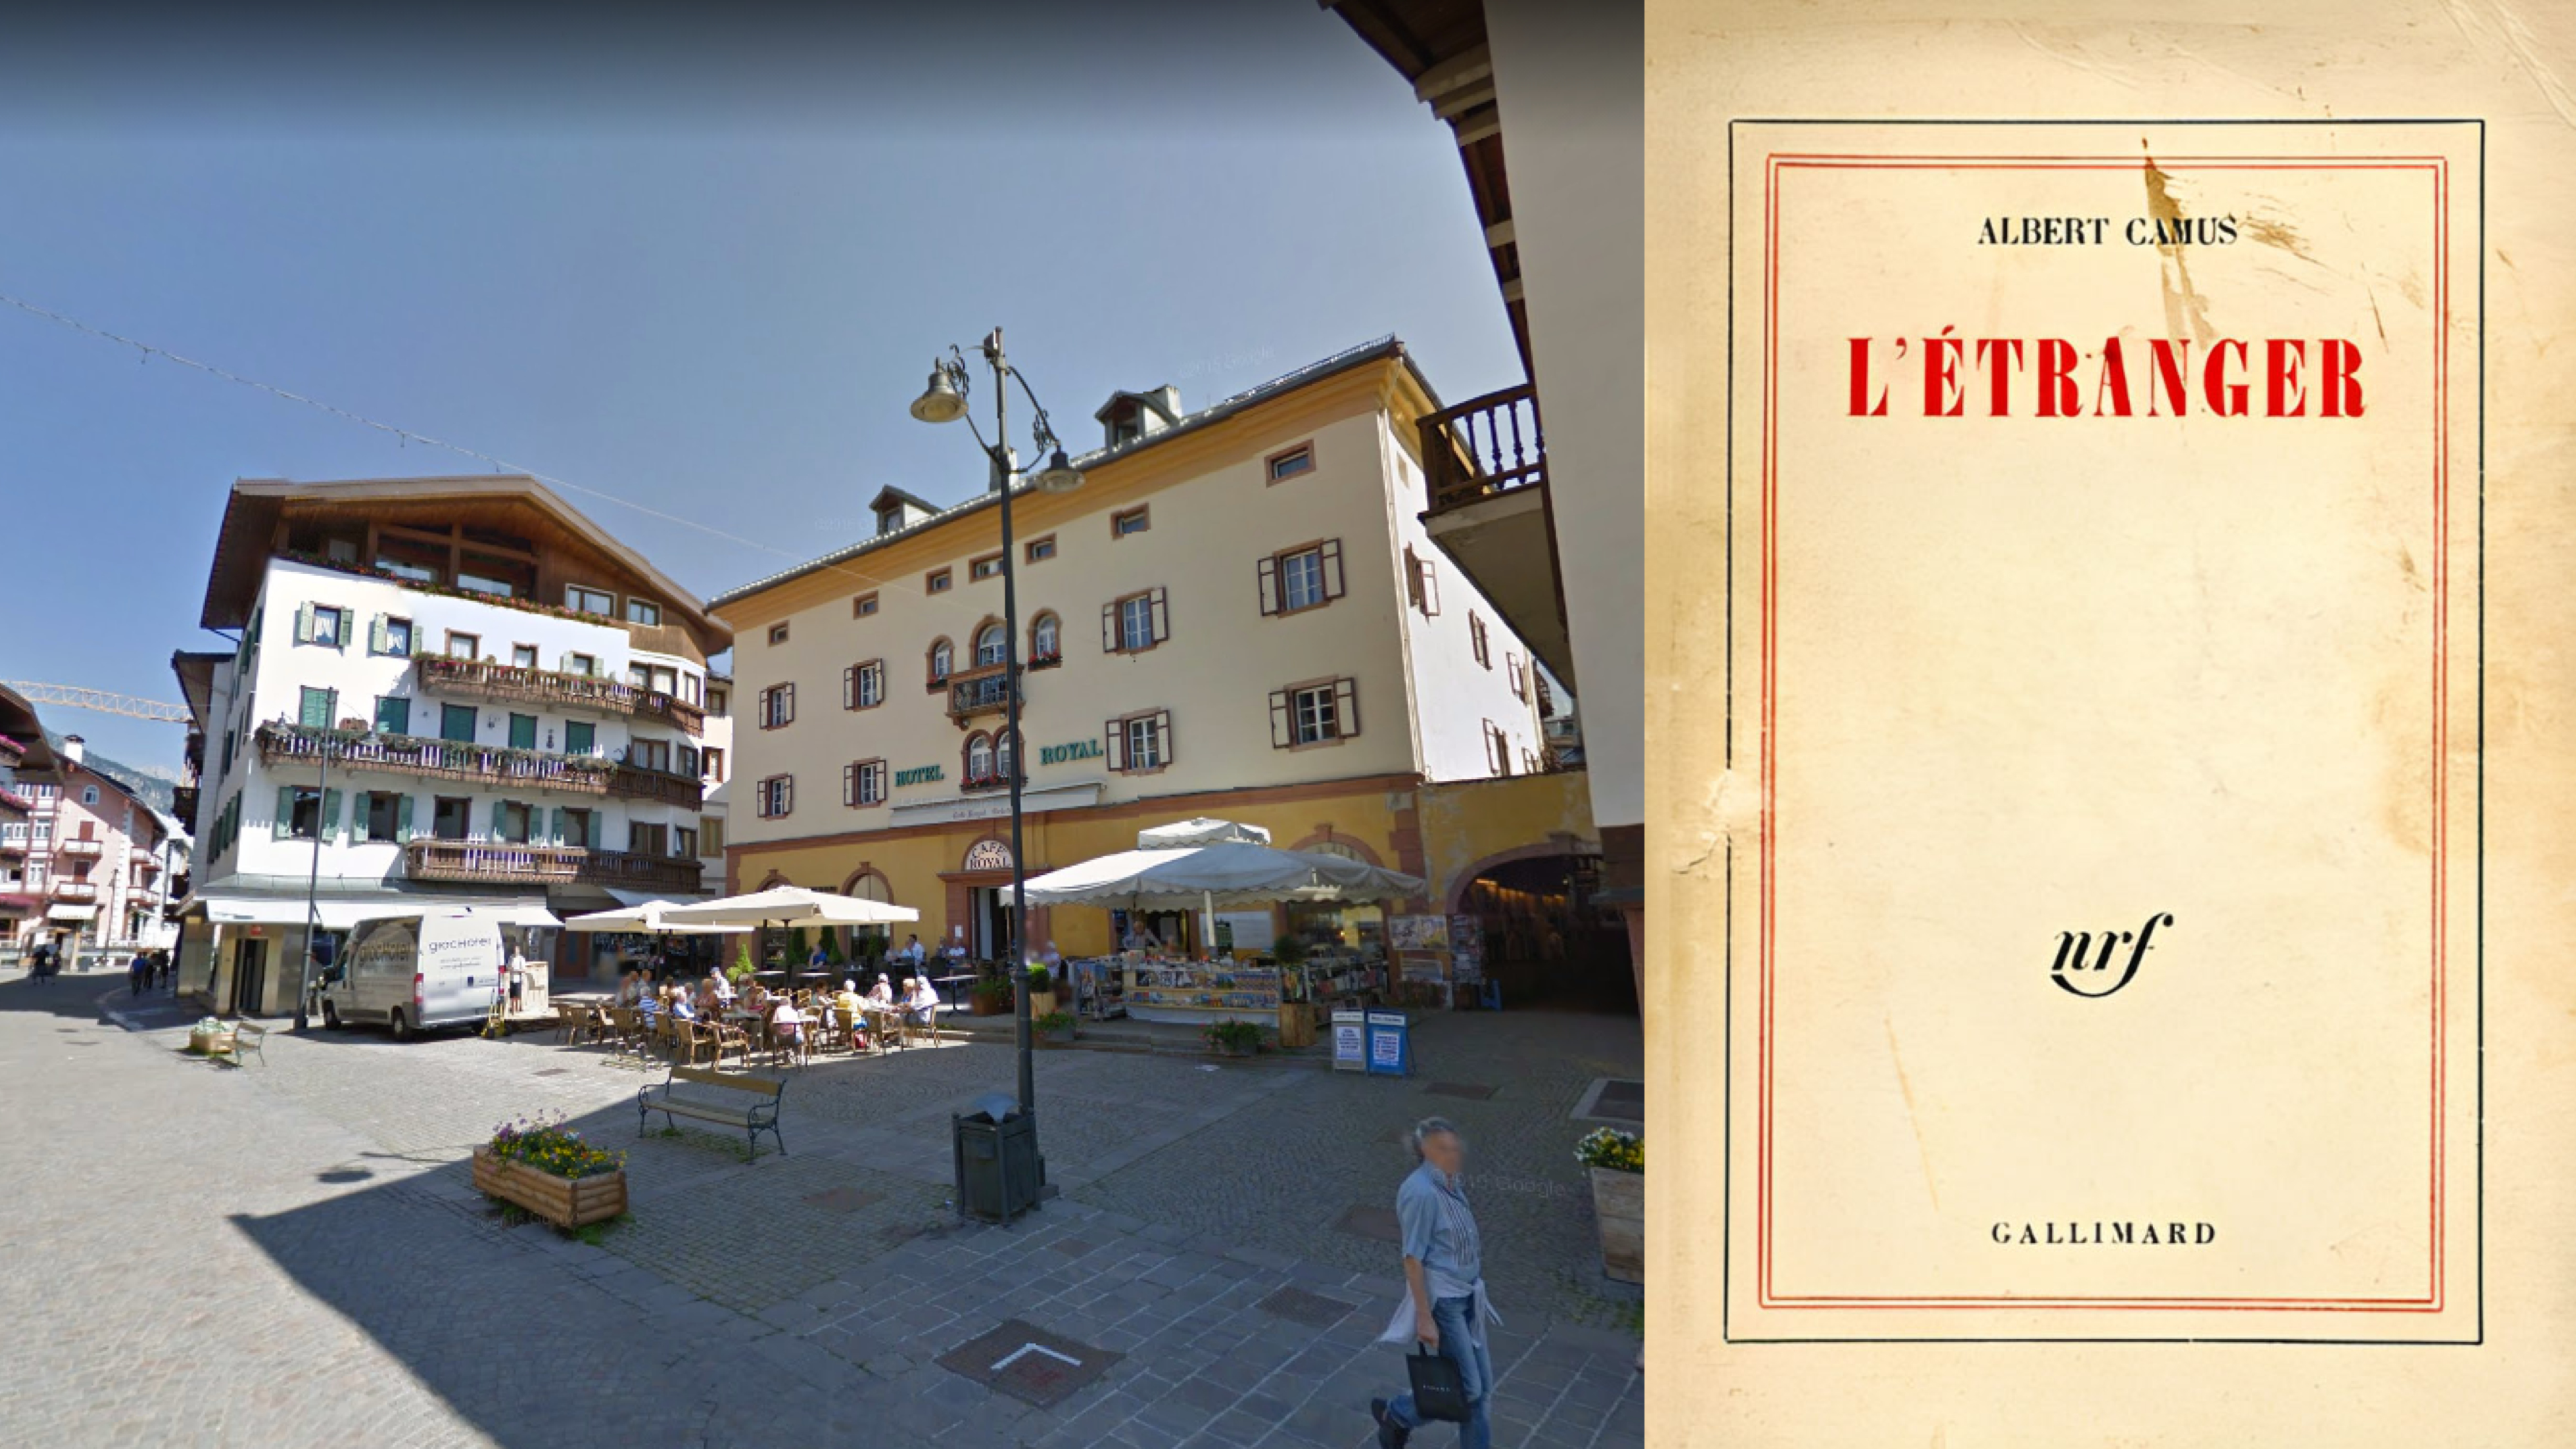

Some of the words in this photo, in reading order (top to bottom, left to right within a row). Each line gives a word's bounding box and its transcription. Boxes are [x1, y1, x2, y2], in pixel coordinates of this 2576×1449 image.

[1978, 216, 2109, 245] ALBERT
[2126, 215, 2238, 246] CAMUS
[1847, 324, 2365, 418] L'ÉTRANGER
[895, 764, 944, 788] HOTEL
[1039, 739, 1103, 766] ROYAL
[970, 856, 1012, 869] ROYAL
[2050, 911, 2174, 999] nrf
[1990, 1222, 2217, 1244] GALLIMARD
